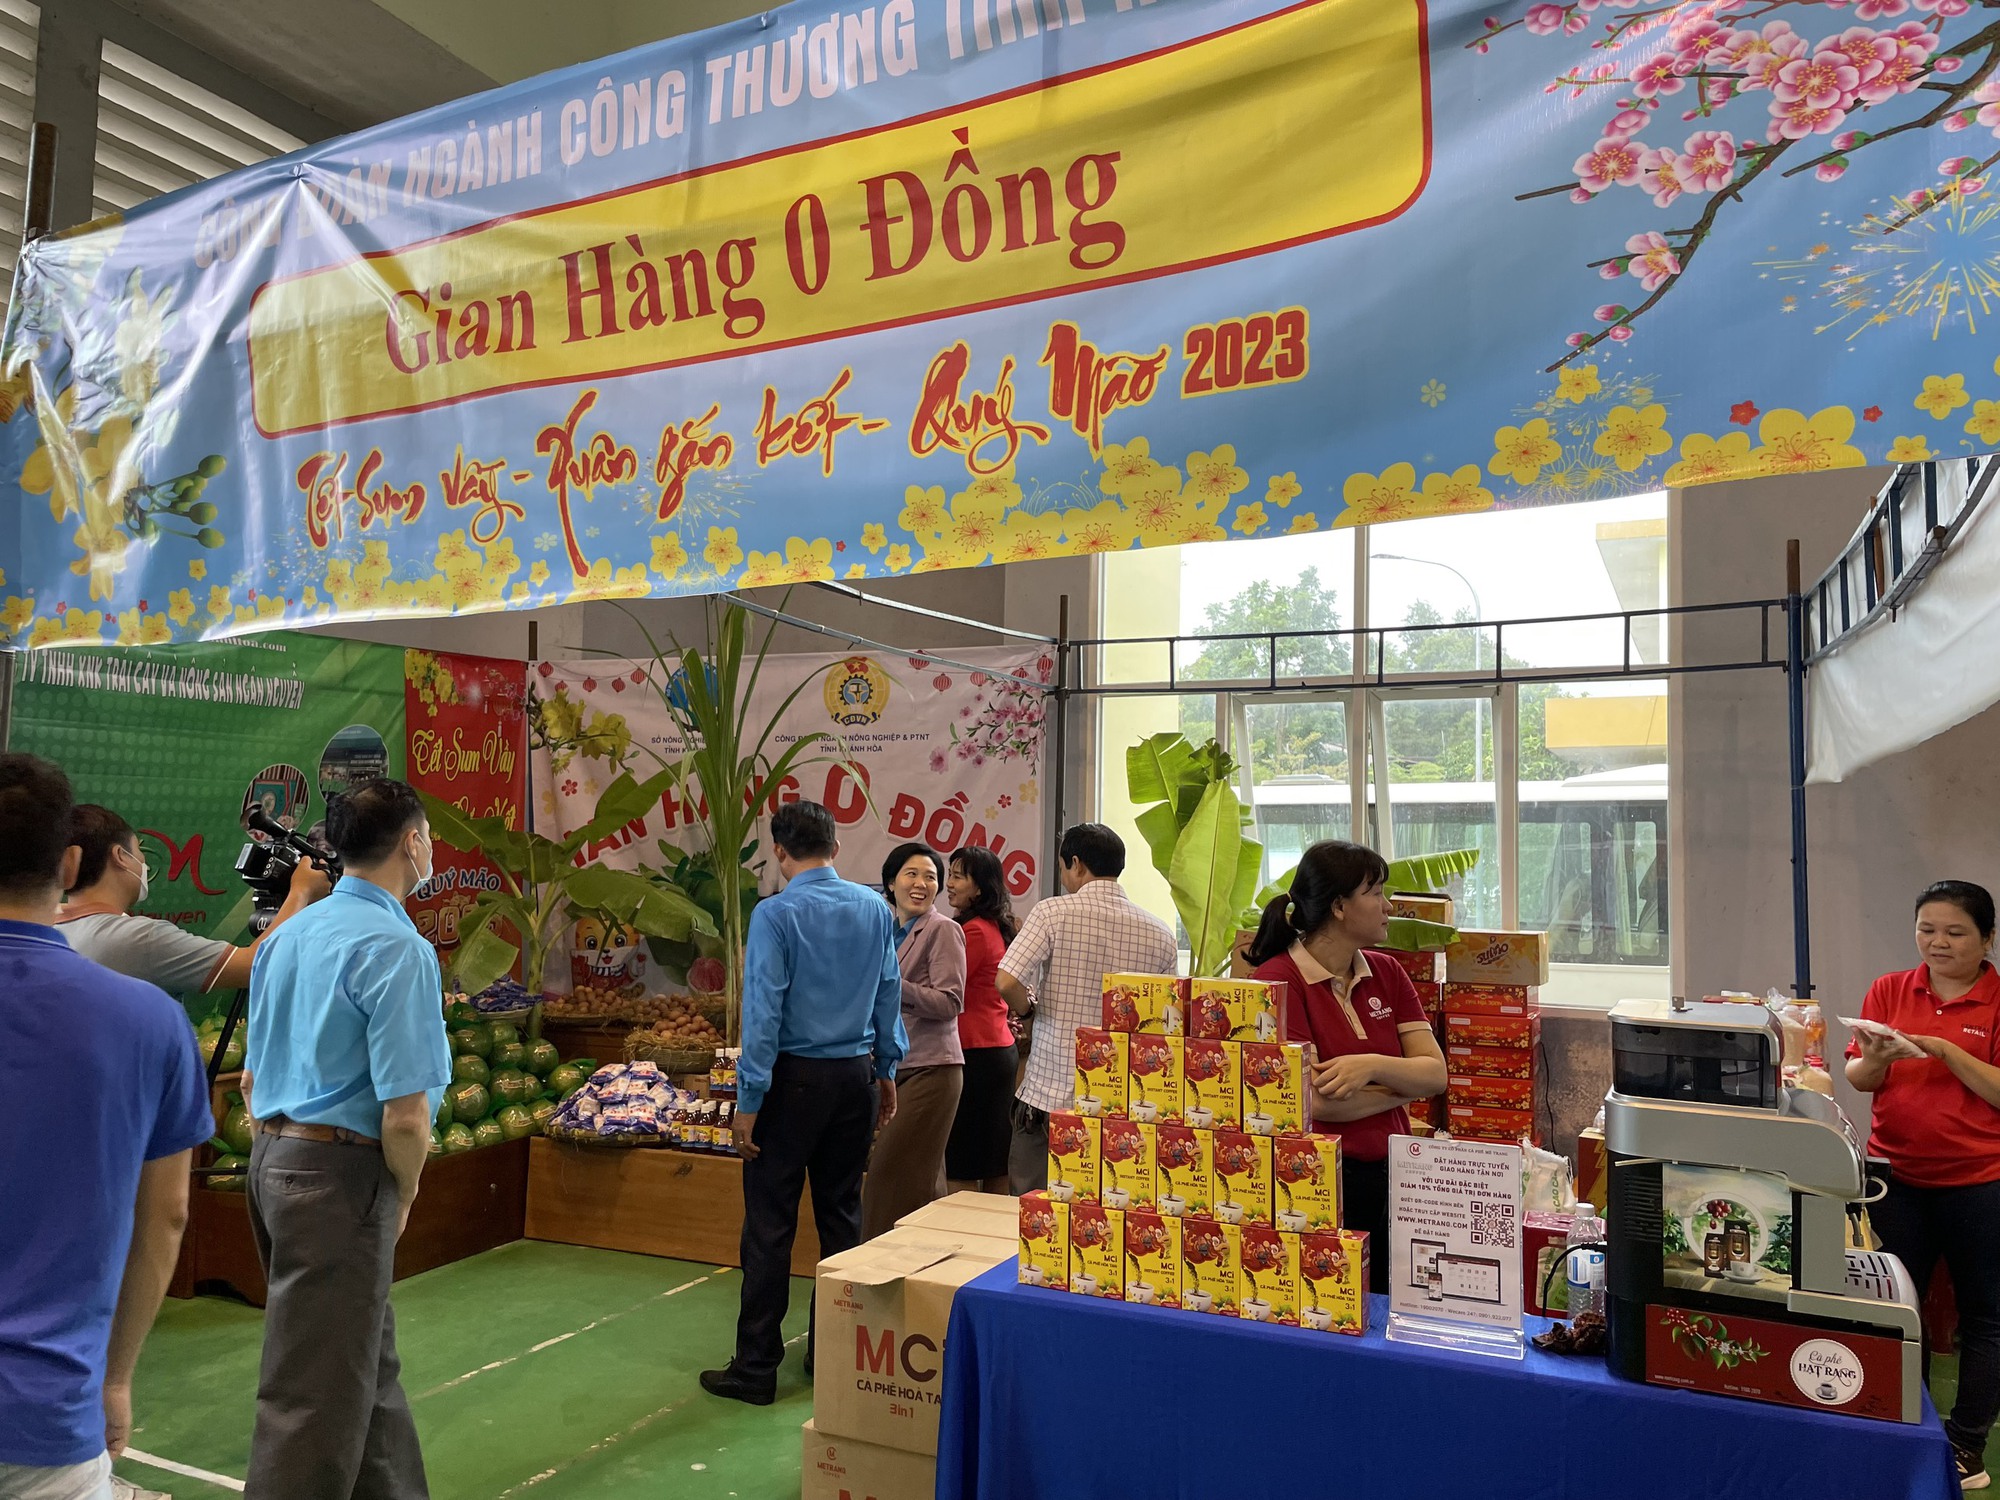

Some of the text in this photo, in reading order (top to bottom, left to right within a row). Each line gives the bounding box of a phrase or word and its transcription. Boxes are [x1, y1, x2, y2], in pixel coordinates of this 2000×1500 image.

[404, 119, 543, 208] NGÀNH
[560, 76, 685, 166] CÔNG
[705, 0, 919, 125] THƯƠNG
[386, 127, 1127, 375] Gian Hàng 0 Đồng
[535, 388, 637, 578] Xuân
[909, 340, 1050, 475] Quý
[1182, 308, 1308, 397] 2023
[41, 649, 75, 686] TNHH
[78, 655, 103, 689] XNK
[106, 647, 131, 693] TRÁI
[134, 652, 159, 695] CÂY
[161, 654, 177, 697] VÀ
[179, 657, 210, 700] NÔNG
[235, 666, 264, 706] NGÂN
[662, 735, 683, 744] NÔNG
[775, 734, 796, 743] CÔNG
[872, 733, 901, 742] NGHIỆP
[910, 733, 930, 741] PTNT
[412, 730, 443, 776] Tết
[444, 727, 480, 781] Sum
[888, 791, 1036, 896] ĐỒNG
[417, 867, 500, 900] QUÝ MÃO
[1963, 1027, 1986, 1038] RETAIL
[1080, 1161, 1094, 1169] MCi
[1448, 1158, 1466, 1166] HÀNG
[1468, 1161, 1486, 1169] TRỰC
[1488, 1160, 1510, 1170] TUYẾN
[1136, 1168, 1150, 1176] MCi
[1456, 1167, 1475, 1175] HÀNG
[1192, 1174, 1207, 1182] MCi
[1251, 1182, 1266, 1190] MCi
[1473, 1181, 1489, 1190] BIỆT
[1315, 1189, 1330, 1197] MCi
[1493, 1191, 1512, 1199] HÀNG
[1441, 1211, 1466, 1219] WEBSITE
[1397, 1215, 1468, 1229] WWW.METRANG.COM
[1050, 1246, 1062, 1254] MCi
[1160, 1262, 1175, 1270] MCi
[1219, 1270, 1234, 1278] MCi
[1279, 1279, 1293, 1287] MCi
[1339, 1287, 1355, 1296] MCi
[834, 1299, 863, 1311] METRANG
[855, 1324, 946, 1383] MC
[1798, 1363, 1857, 1381] HẠT RANG
[874, 1382, 897, 1397] PHÊ
[926, 1392, 942, 1405] TA
[817, 1461, 846, 1475] METRANG
